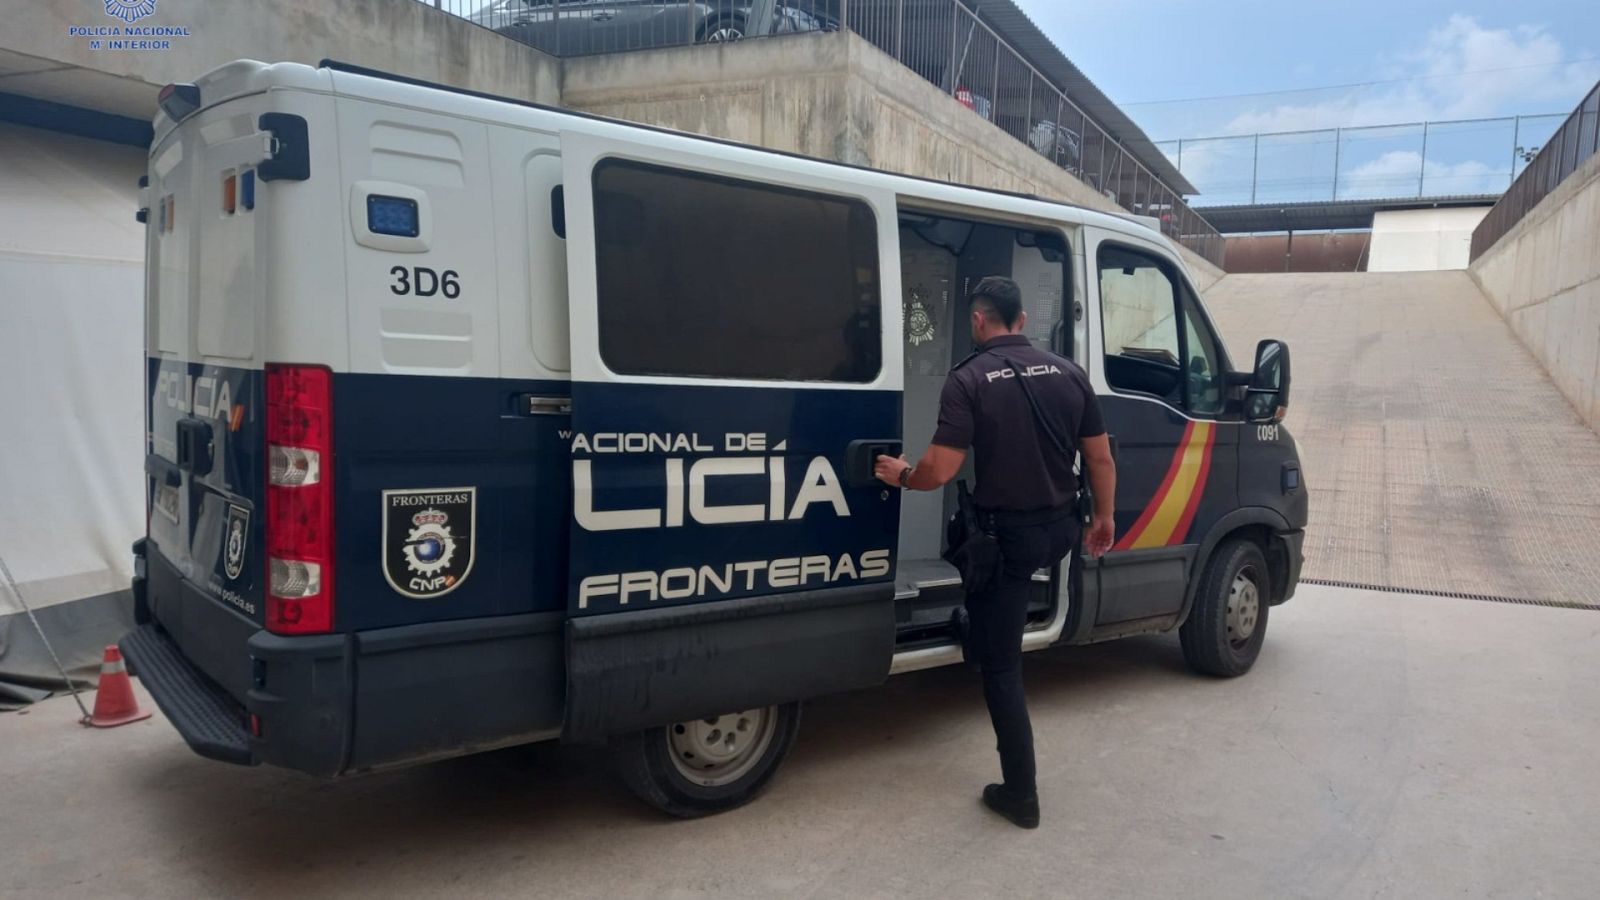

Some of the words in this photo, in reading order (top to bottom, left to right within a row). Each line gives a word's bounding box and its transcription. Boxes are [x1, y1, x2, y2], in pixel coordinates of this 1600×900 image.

[390, 265, 461, 299] 3D6
[571, 432, 714, 453] ACIONAL
[725, 432, 767, 452] DE
[573, 439, 851, 531] LICÍA
[392, 493, 469, 507] FRONTERAS
[408, 576, 446, 591] CNP
[579, 549, 890, 609] FRONTERAS
